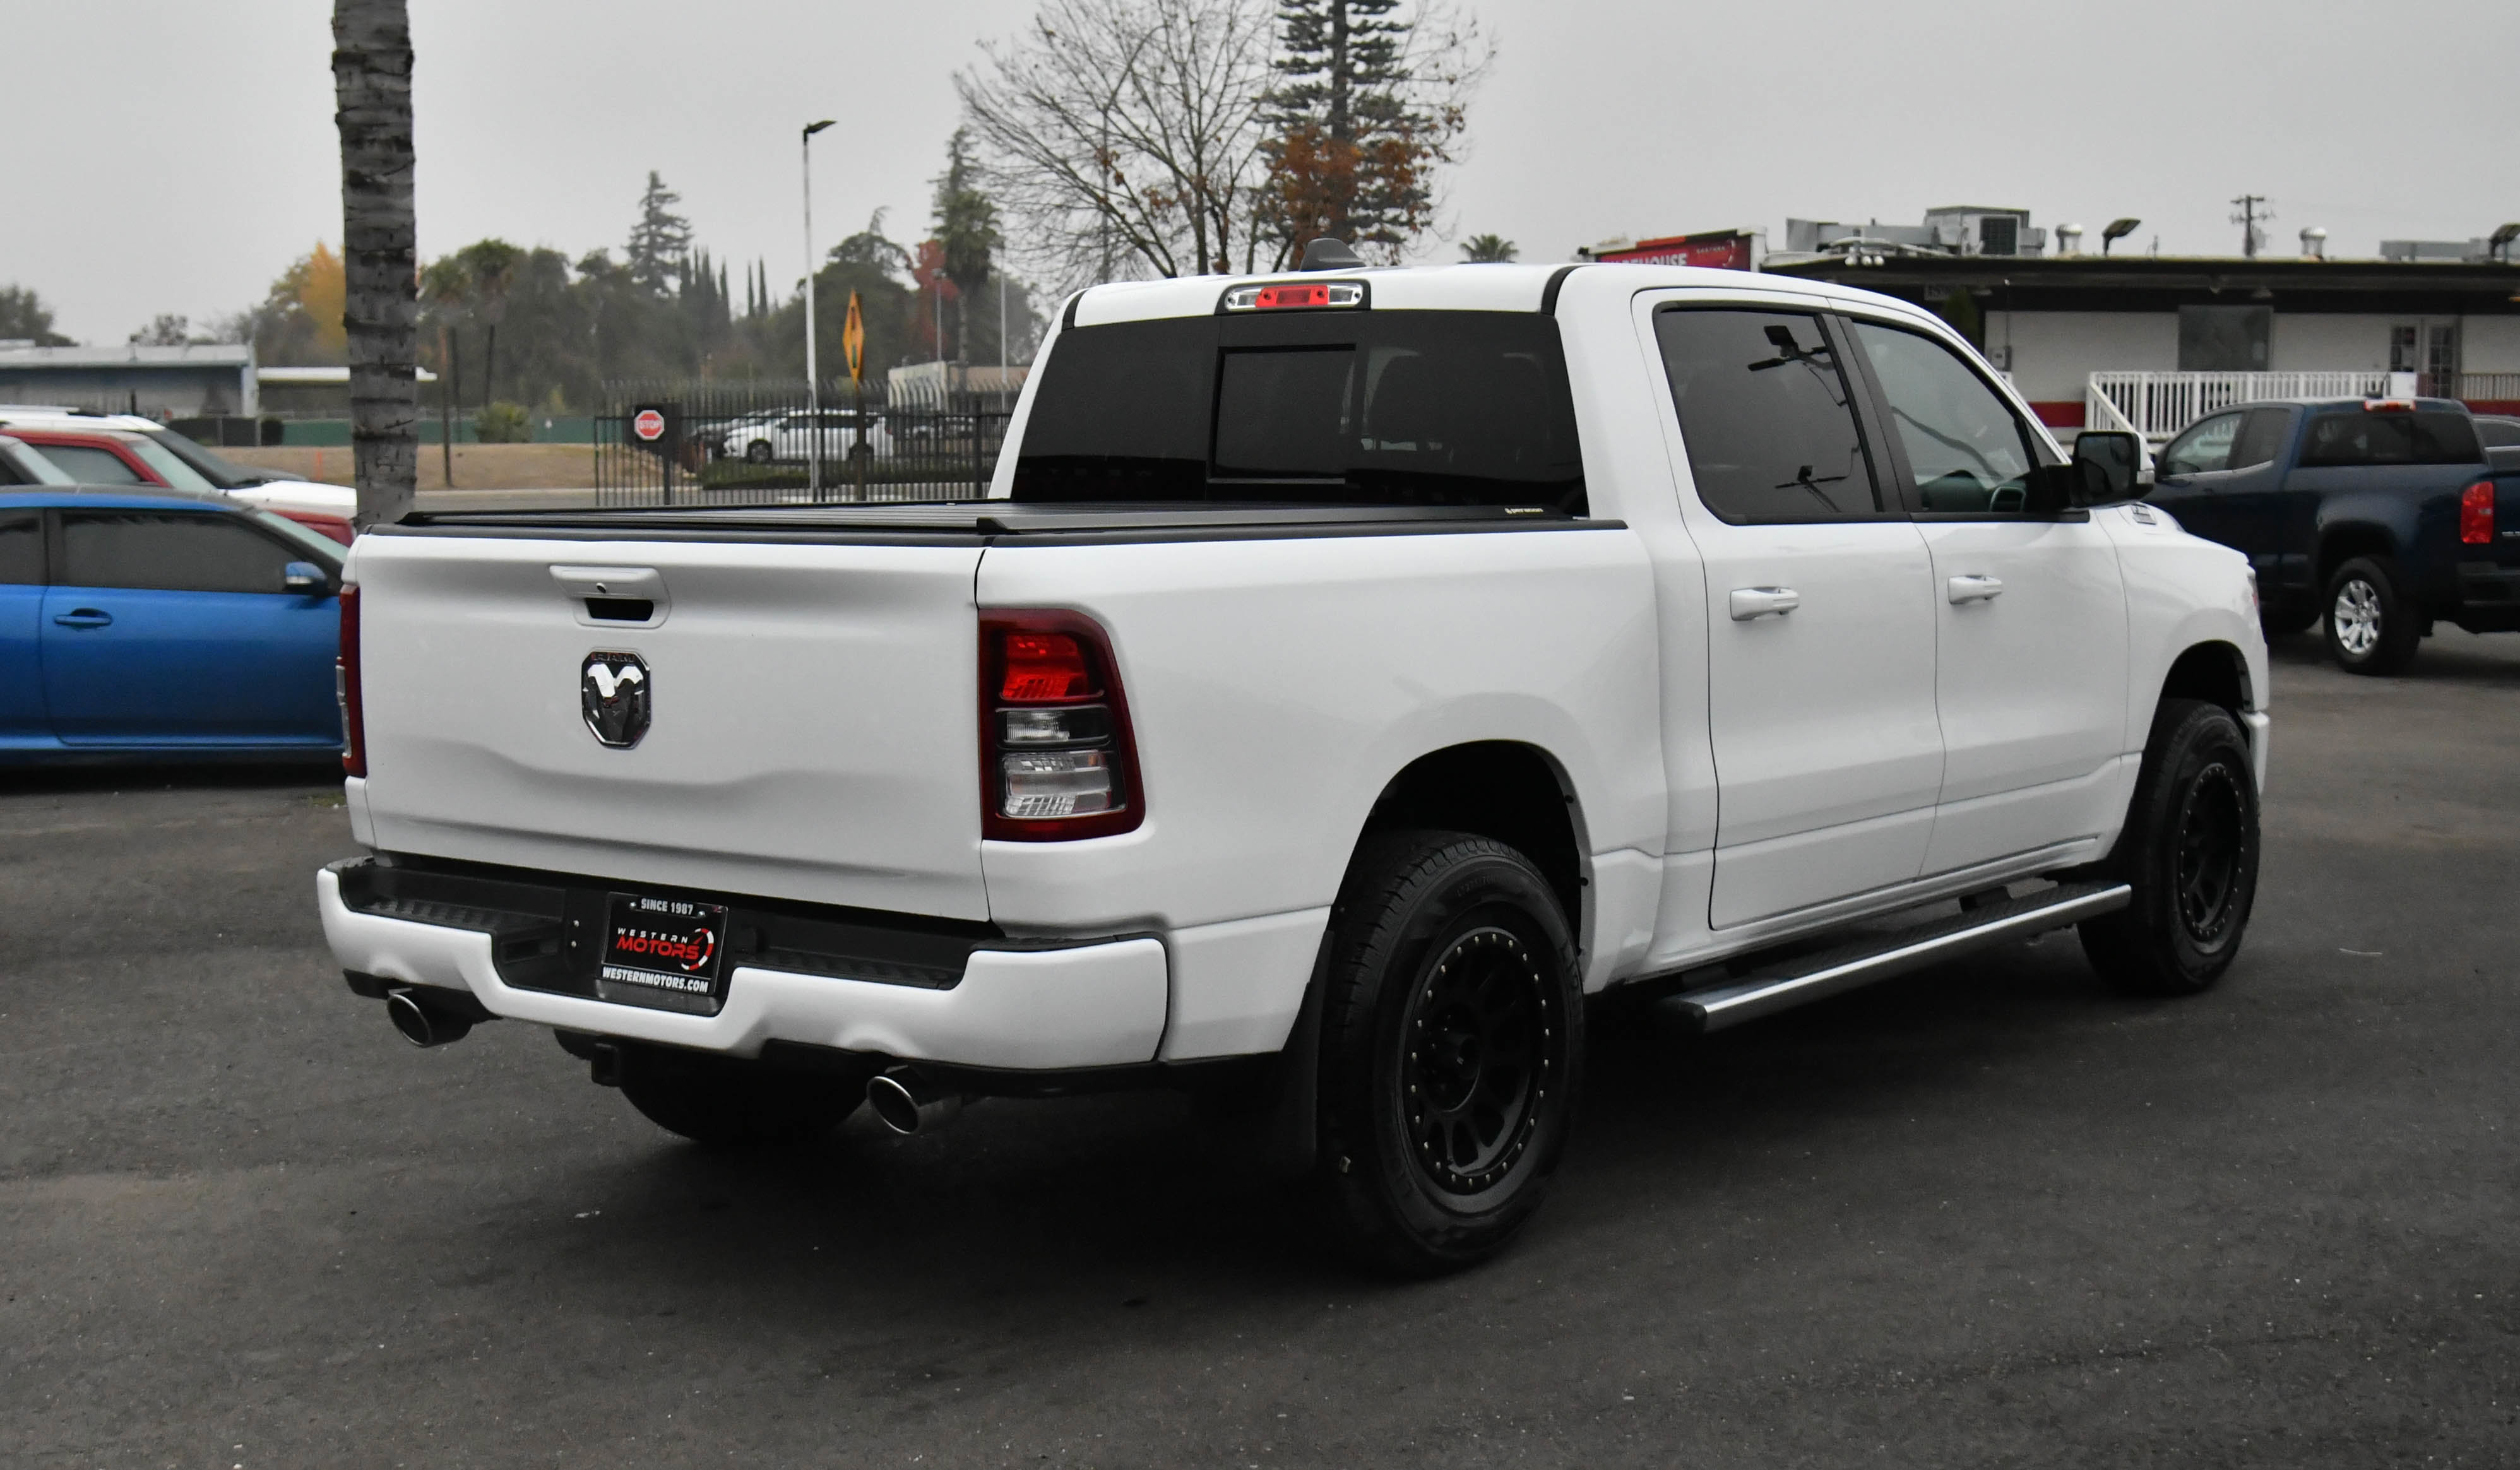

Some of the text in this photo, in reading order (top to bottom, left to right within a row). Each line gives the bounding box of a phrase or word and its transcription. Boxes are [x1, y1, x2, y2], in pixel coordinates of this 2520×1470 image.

[641, 898, 694, 915] SINCE 1987
[617, 927, 688, 944] WESTERN
[616, 935, 700, 960] MOTORS
[602, 966, 708, 993] WESTERNMOTORS.COM
